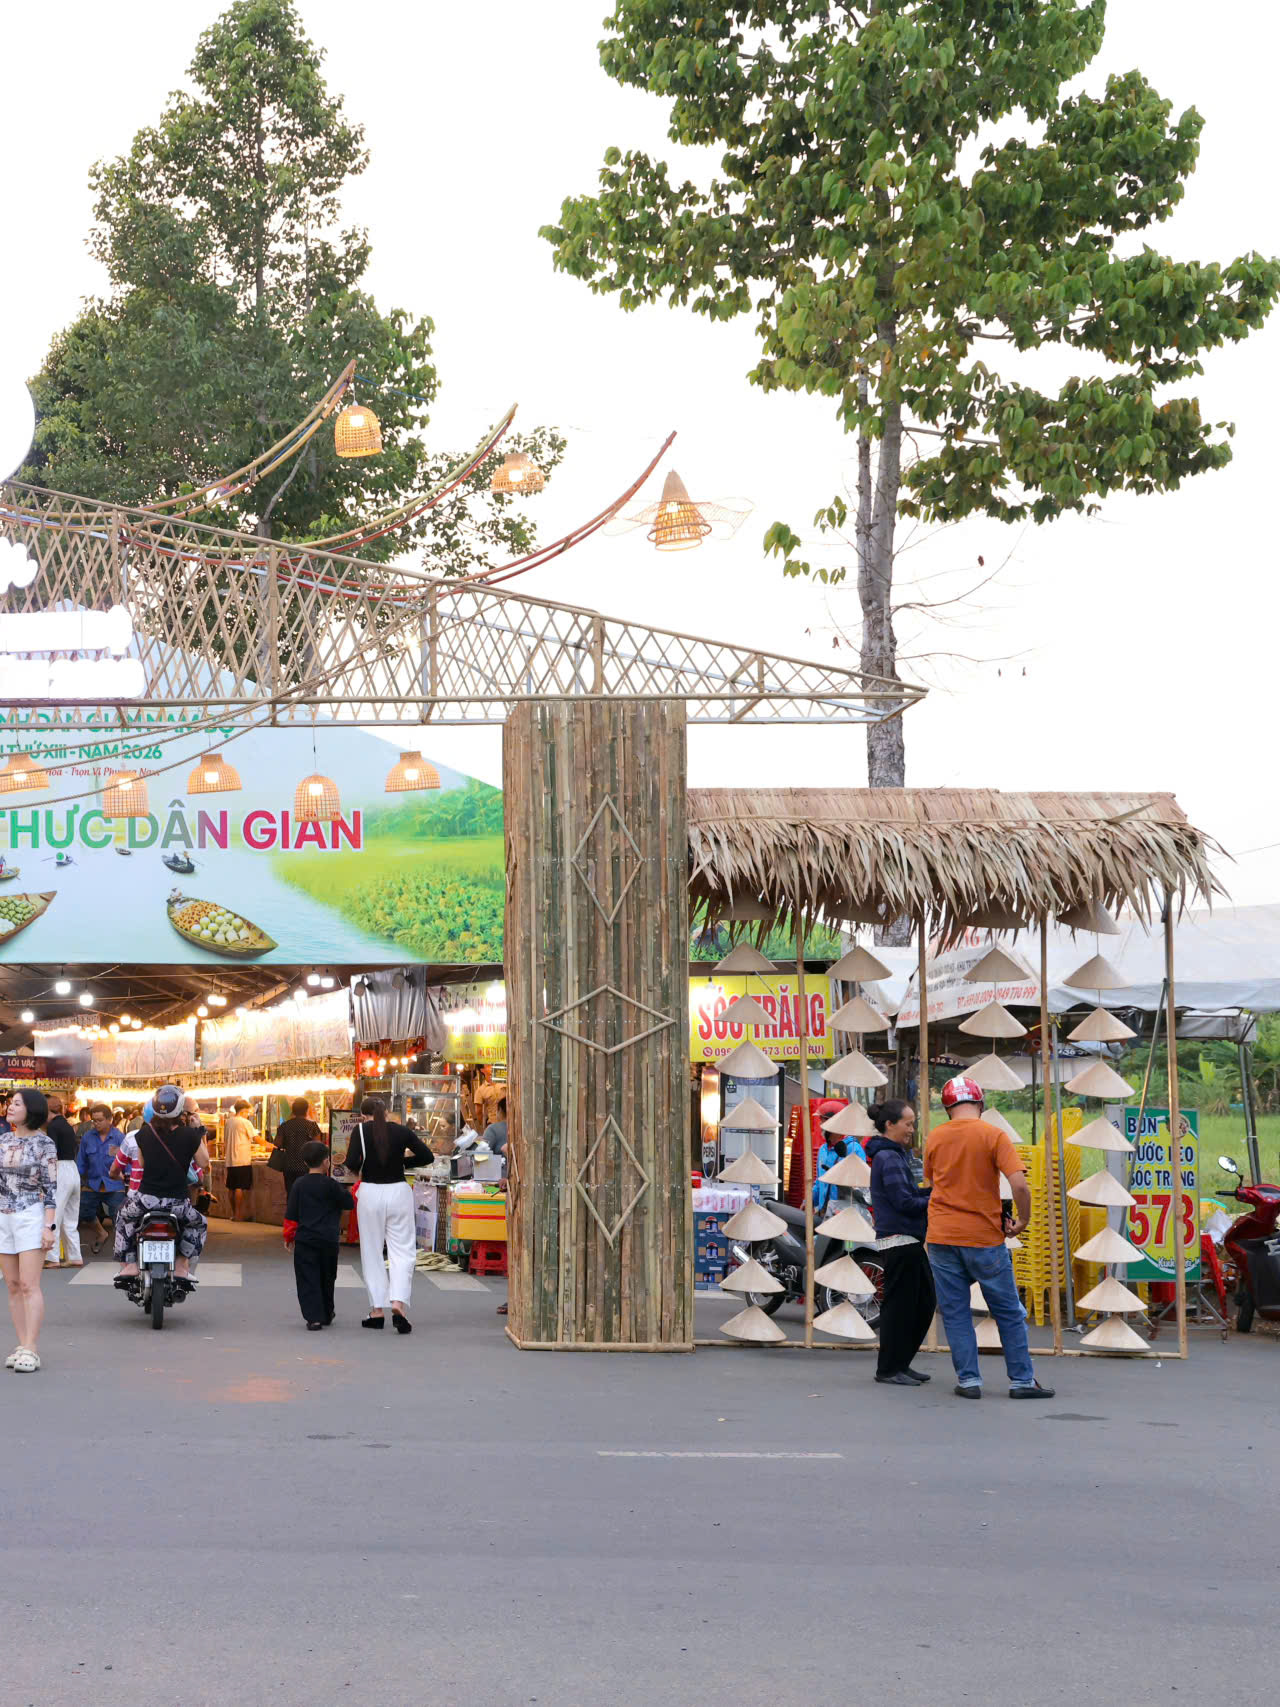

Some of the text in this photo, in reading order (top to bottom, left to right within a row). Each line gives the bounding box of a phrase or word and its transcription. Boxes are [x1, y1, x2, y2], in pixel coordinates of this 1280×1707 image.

[122, 743, 163, 760] 2026
[128, 799, 228, 849] DÂN
[243, 810, 361, 850] GIAN
[703, 1146, 716, 1158] PEPSI
[1155, 1170, 1195, 1187] TRNG
